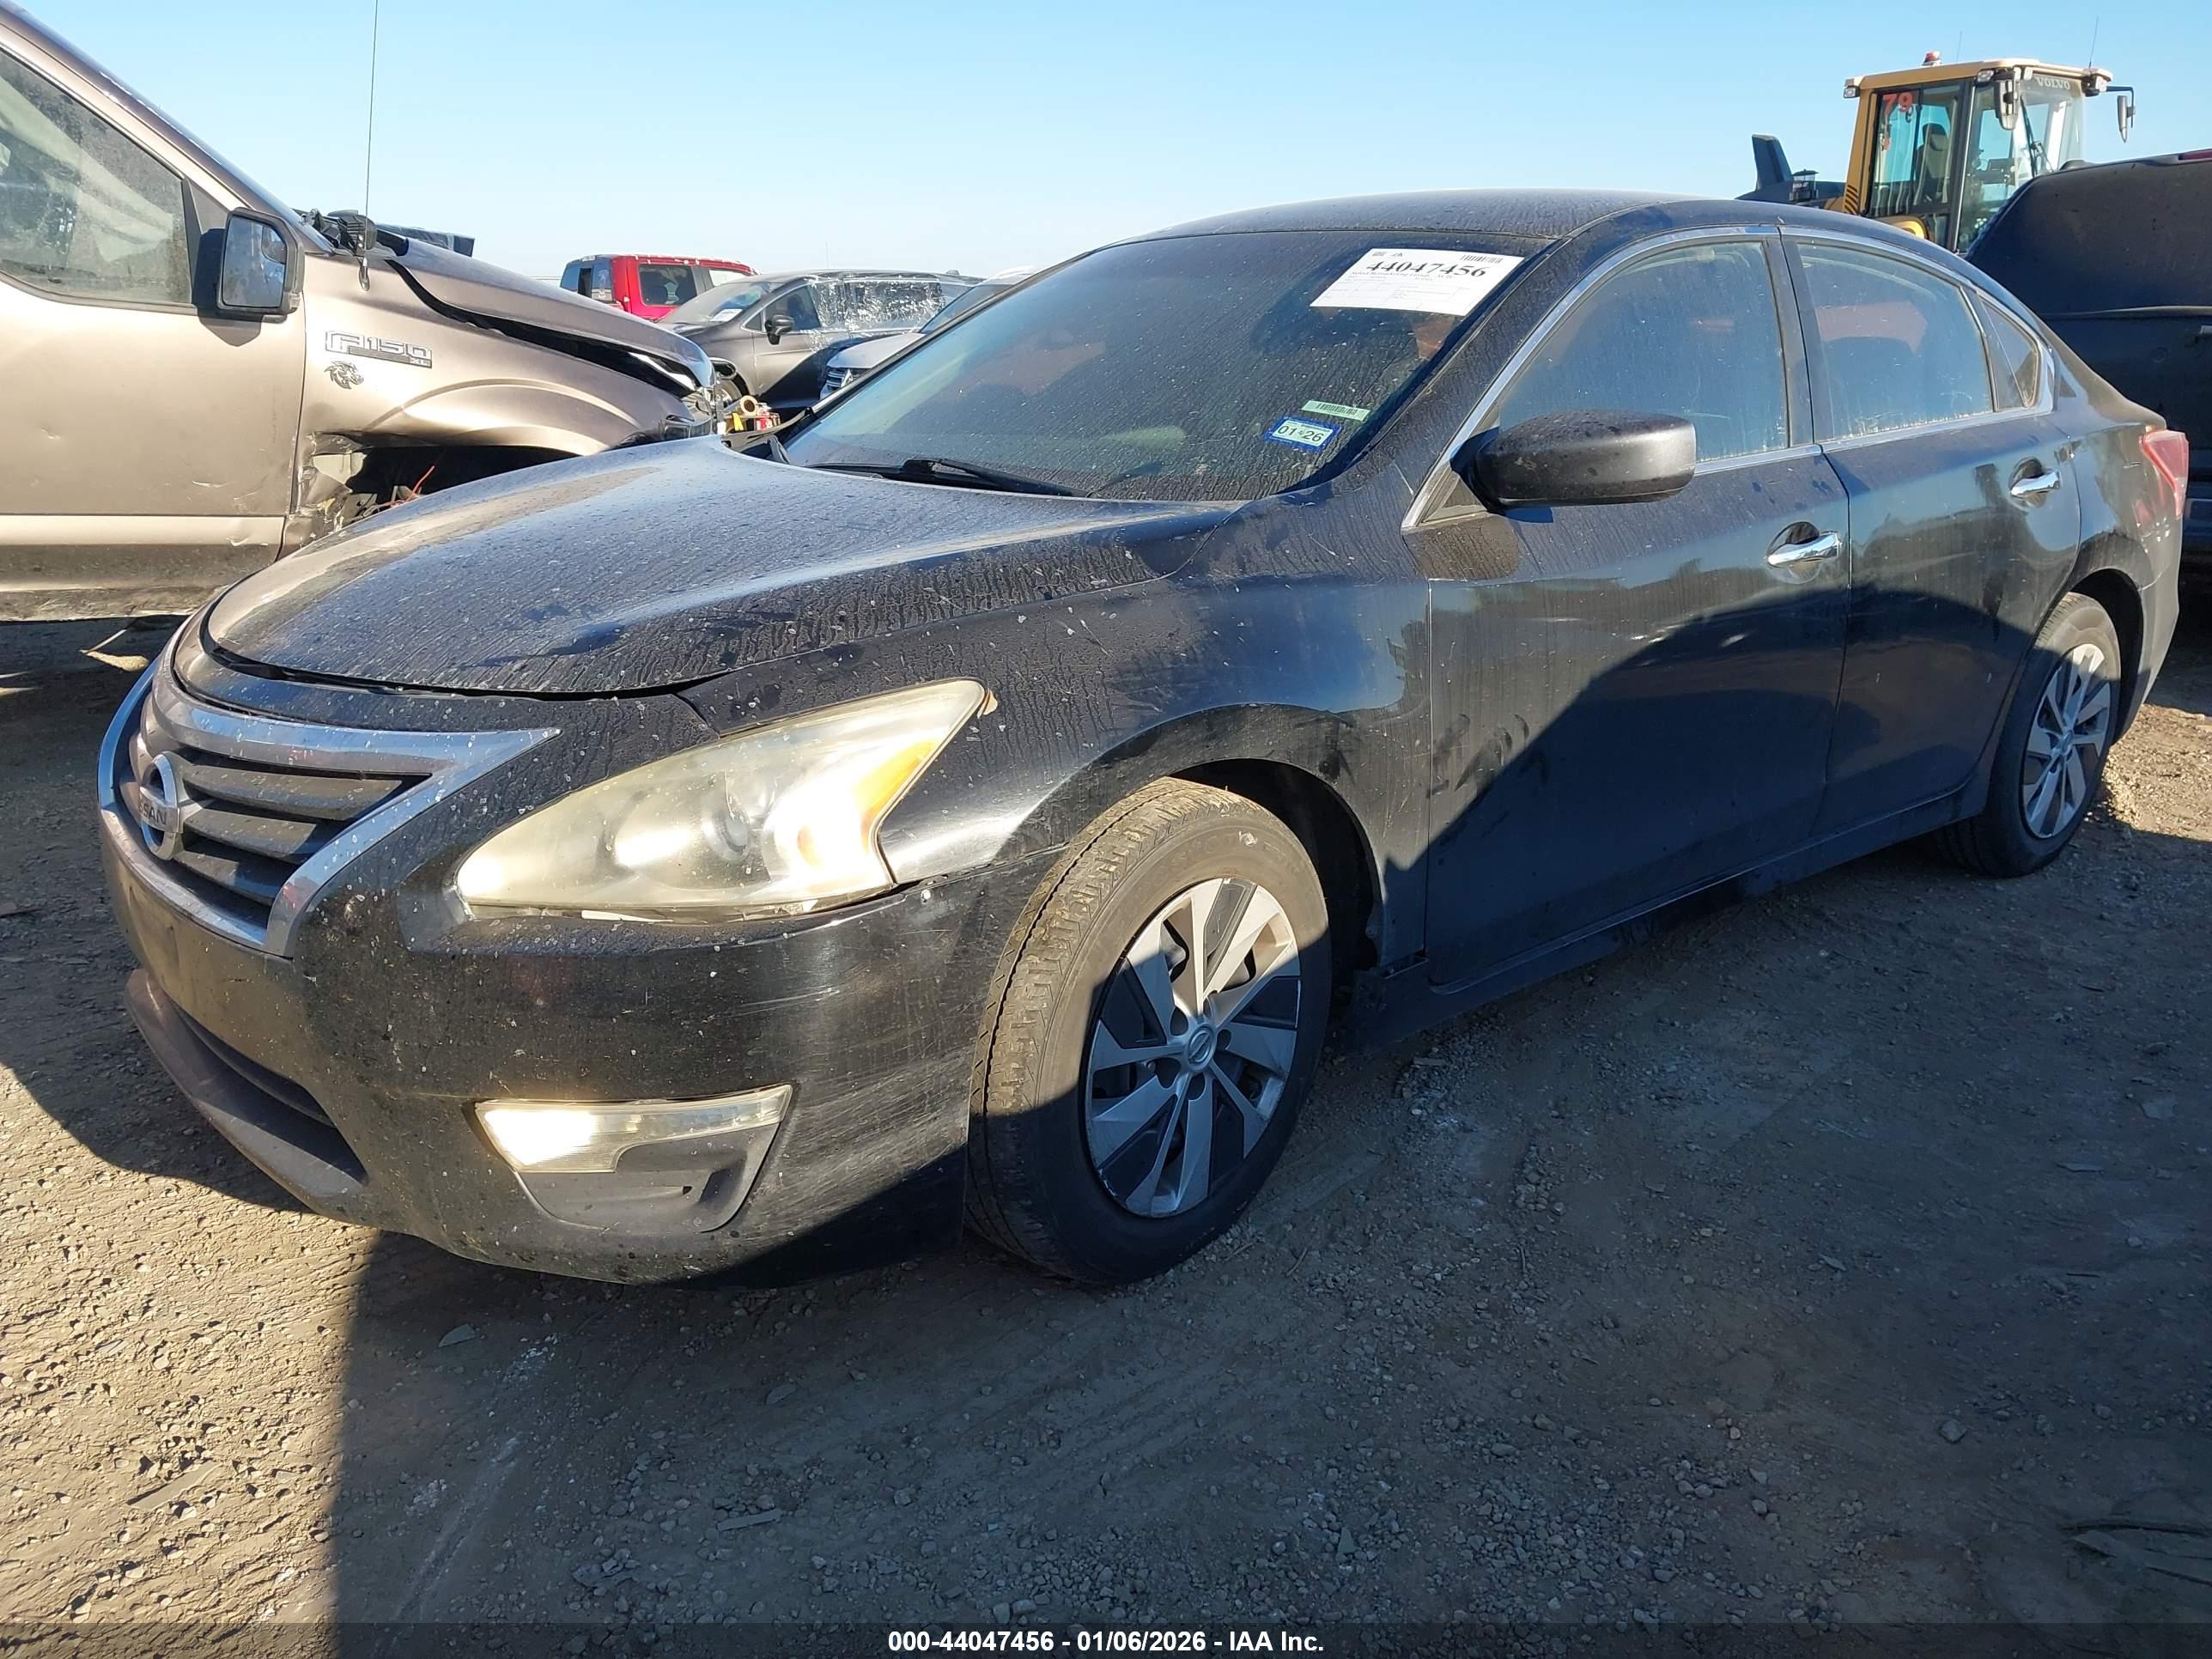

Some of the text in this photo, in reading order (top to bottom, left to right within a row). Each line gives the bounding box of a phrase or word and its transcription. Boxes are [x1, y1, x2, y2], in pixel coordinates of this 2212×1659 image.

[2036, 76, 2071, 90] VOLVO
[1882, 92, 1913, 115] 79
[1366, 260, 1489, 278] 44047456
